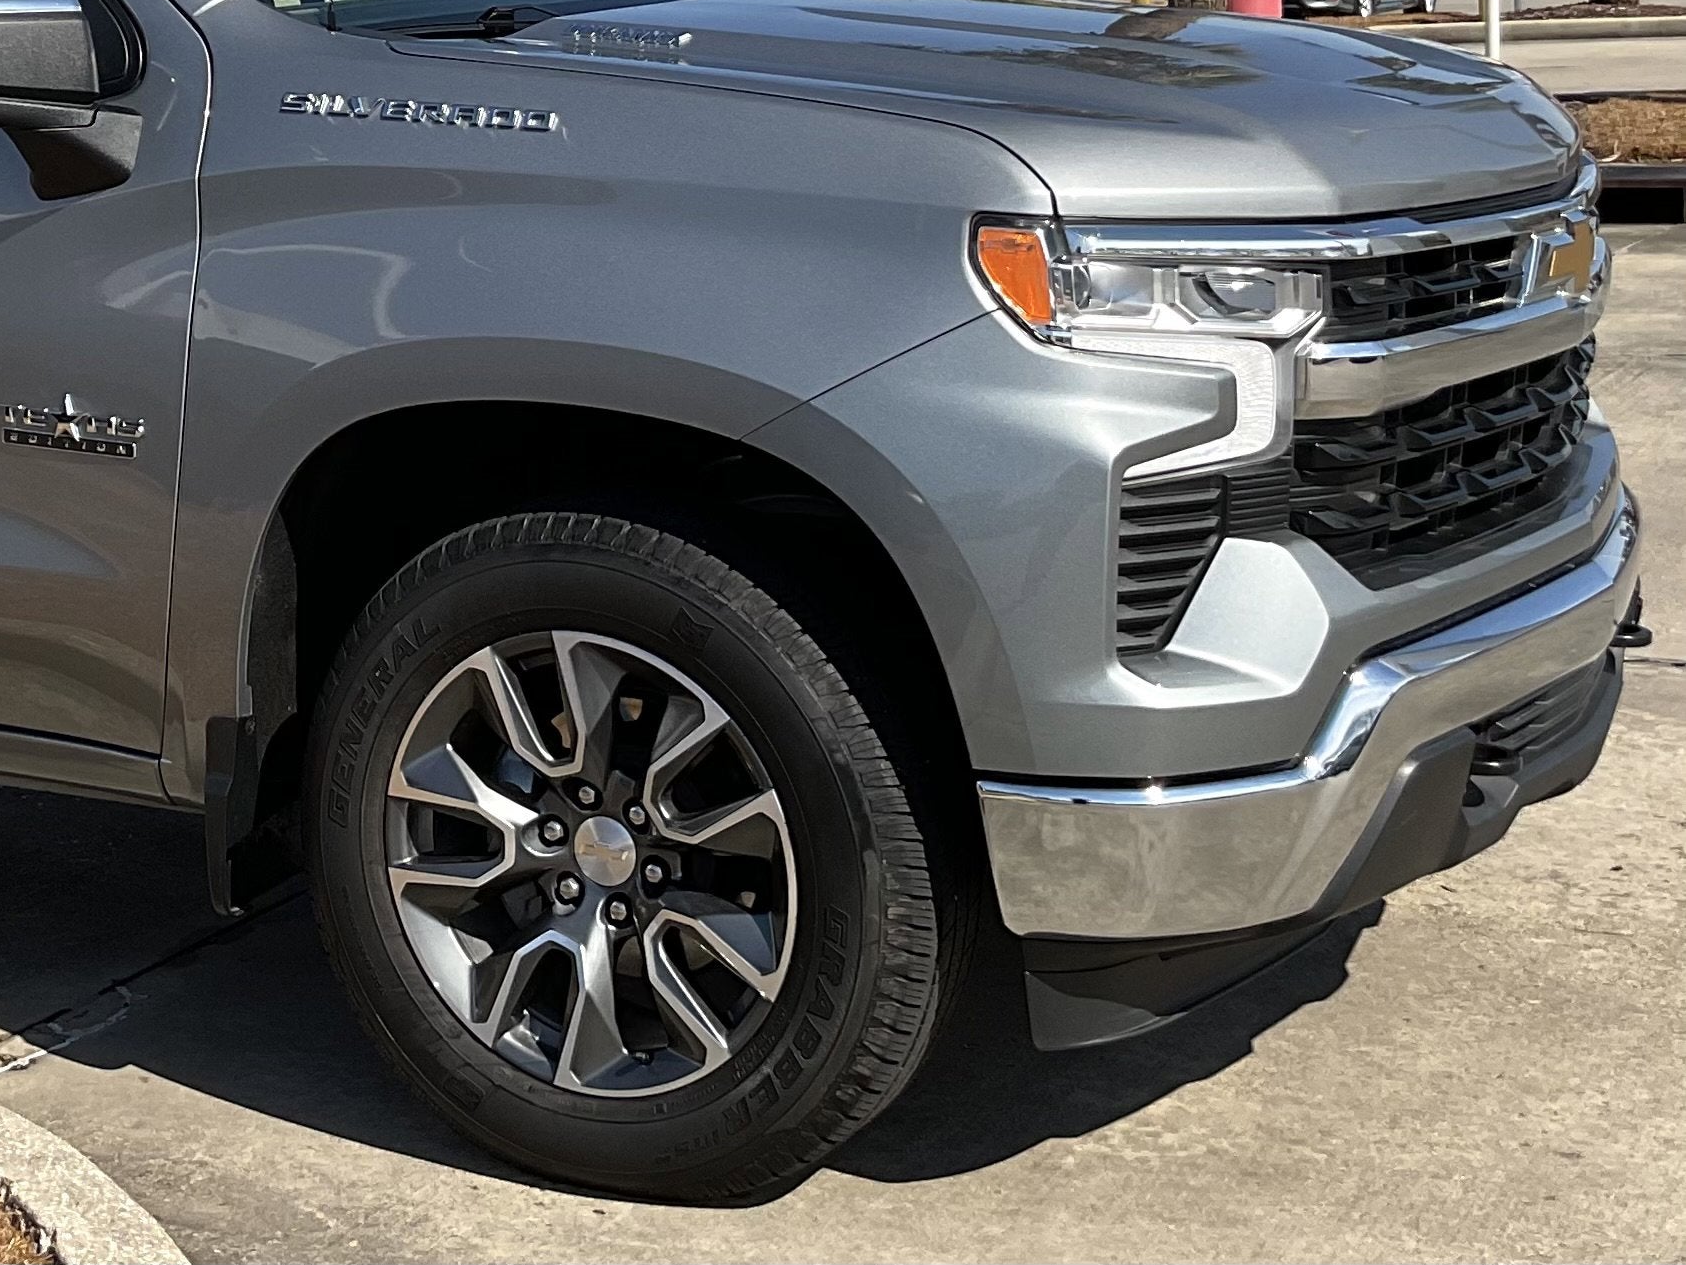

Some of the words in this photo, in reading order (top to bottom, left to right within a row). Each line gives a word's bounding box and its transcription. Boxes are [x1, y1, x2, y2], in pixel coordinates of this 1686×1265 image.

[279, 91, 560, 133] SILVERADO
[327, 617, 443, 829] GENERAL
[721, 903, 852, 1136] GRABBER
